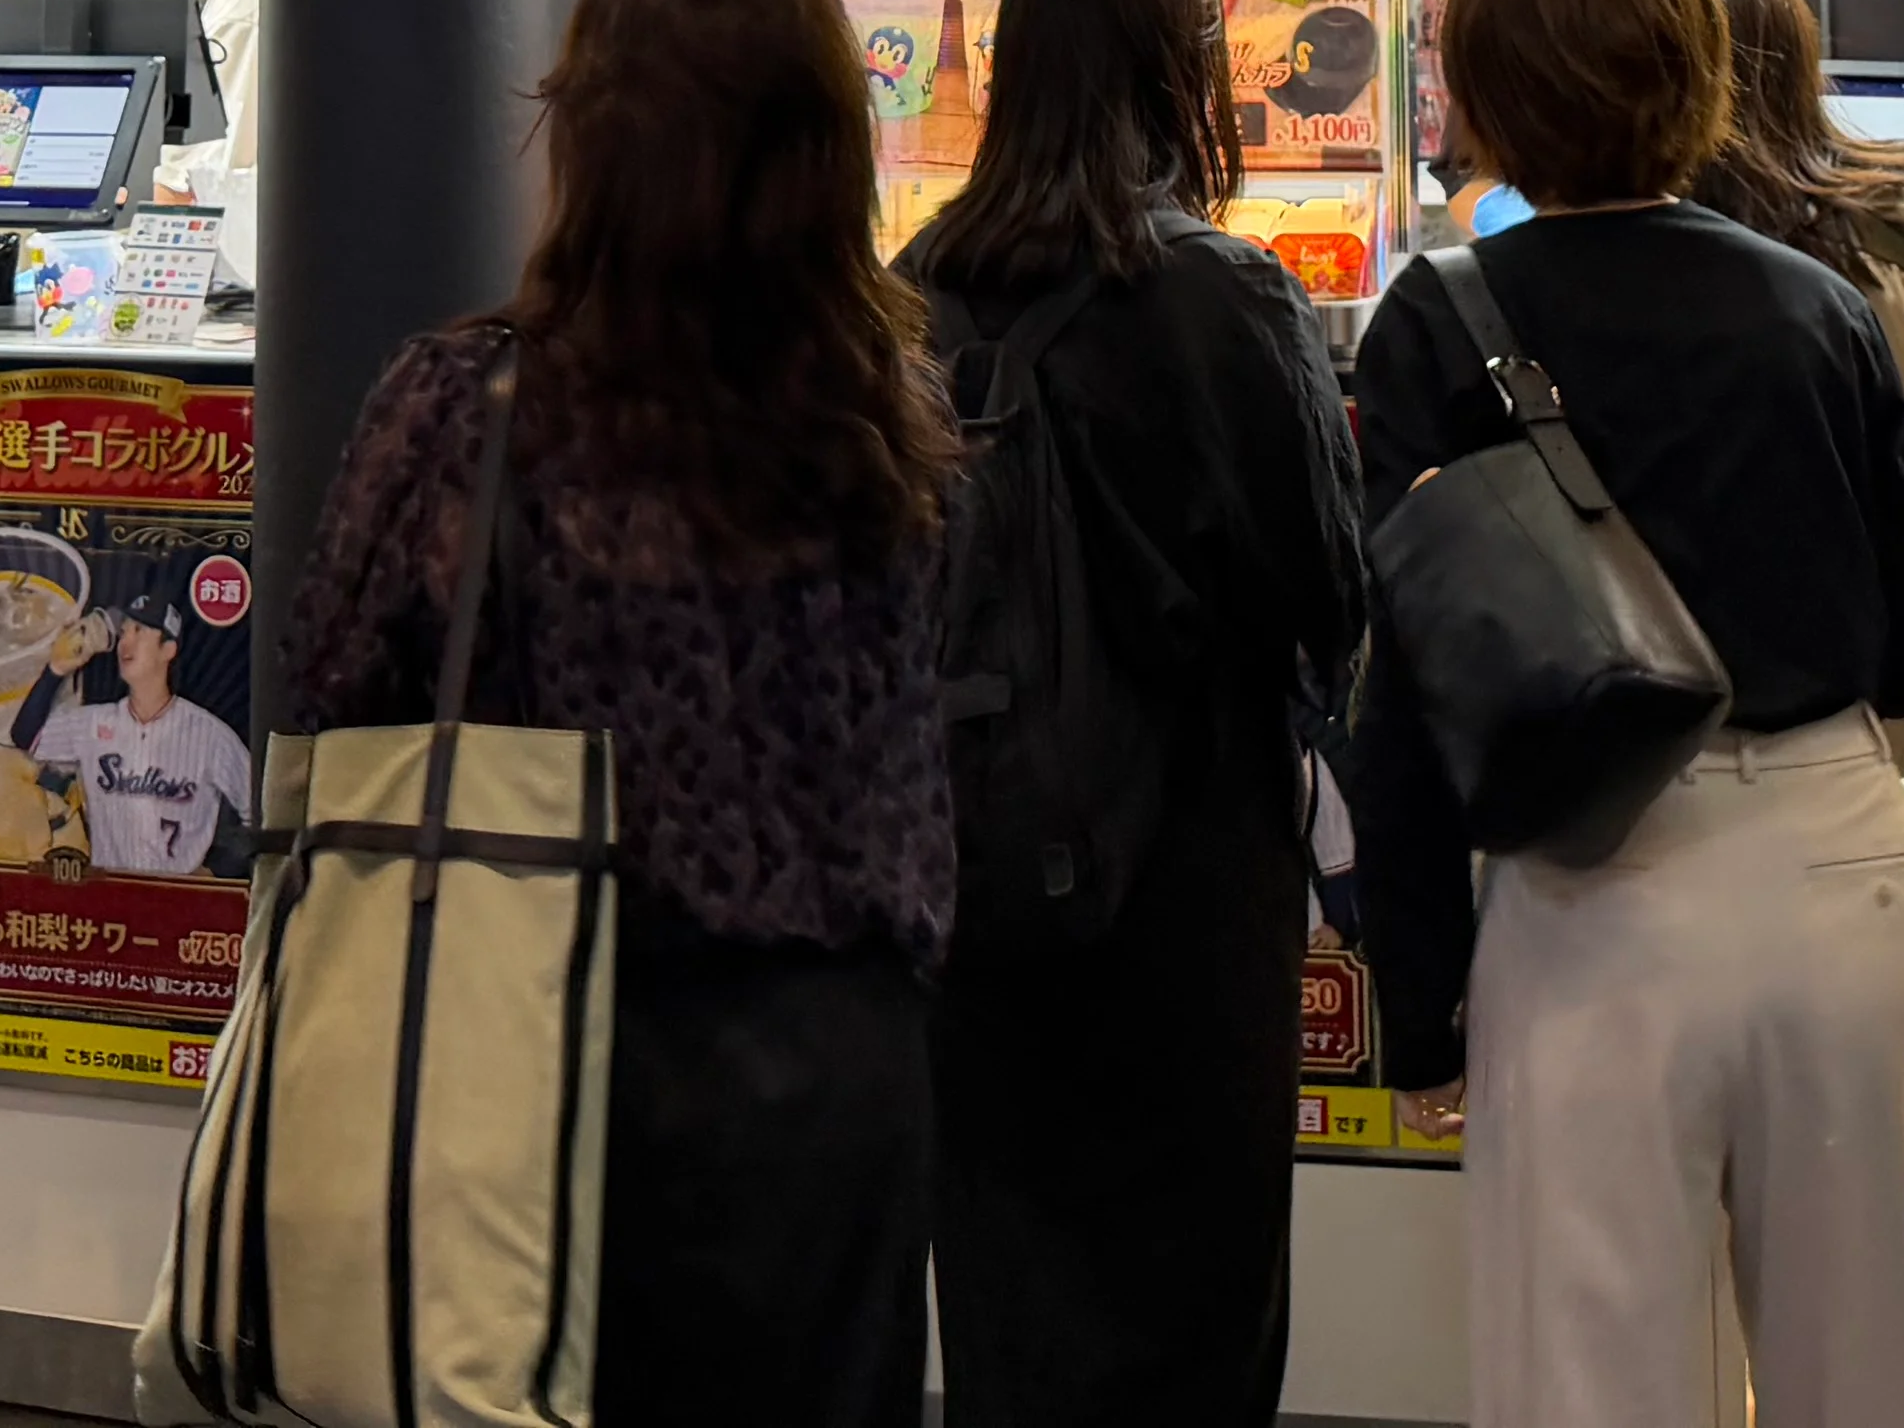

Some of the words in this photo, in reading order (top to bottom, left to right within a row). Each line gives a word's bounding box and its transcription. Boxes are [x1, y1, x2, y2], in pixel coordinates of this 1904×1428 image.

[1, 378, 85, 394] SWALLOWS
[88, 379, 162, 399] GOURMET
[200, 579, 241, 605] お酒
[98, 753, 196, 801] Swallows
[160, 820, 180, 858] 7
[53, 859, 81, 882] 100
[1334, 1117, 1367, 1133] です
